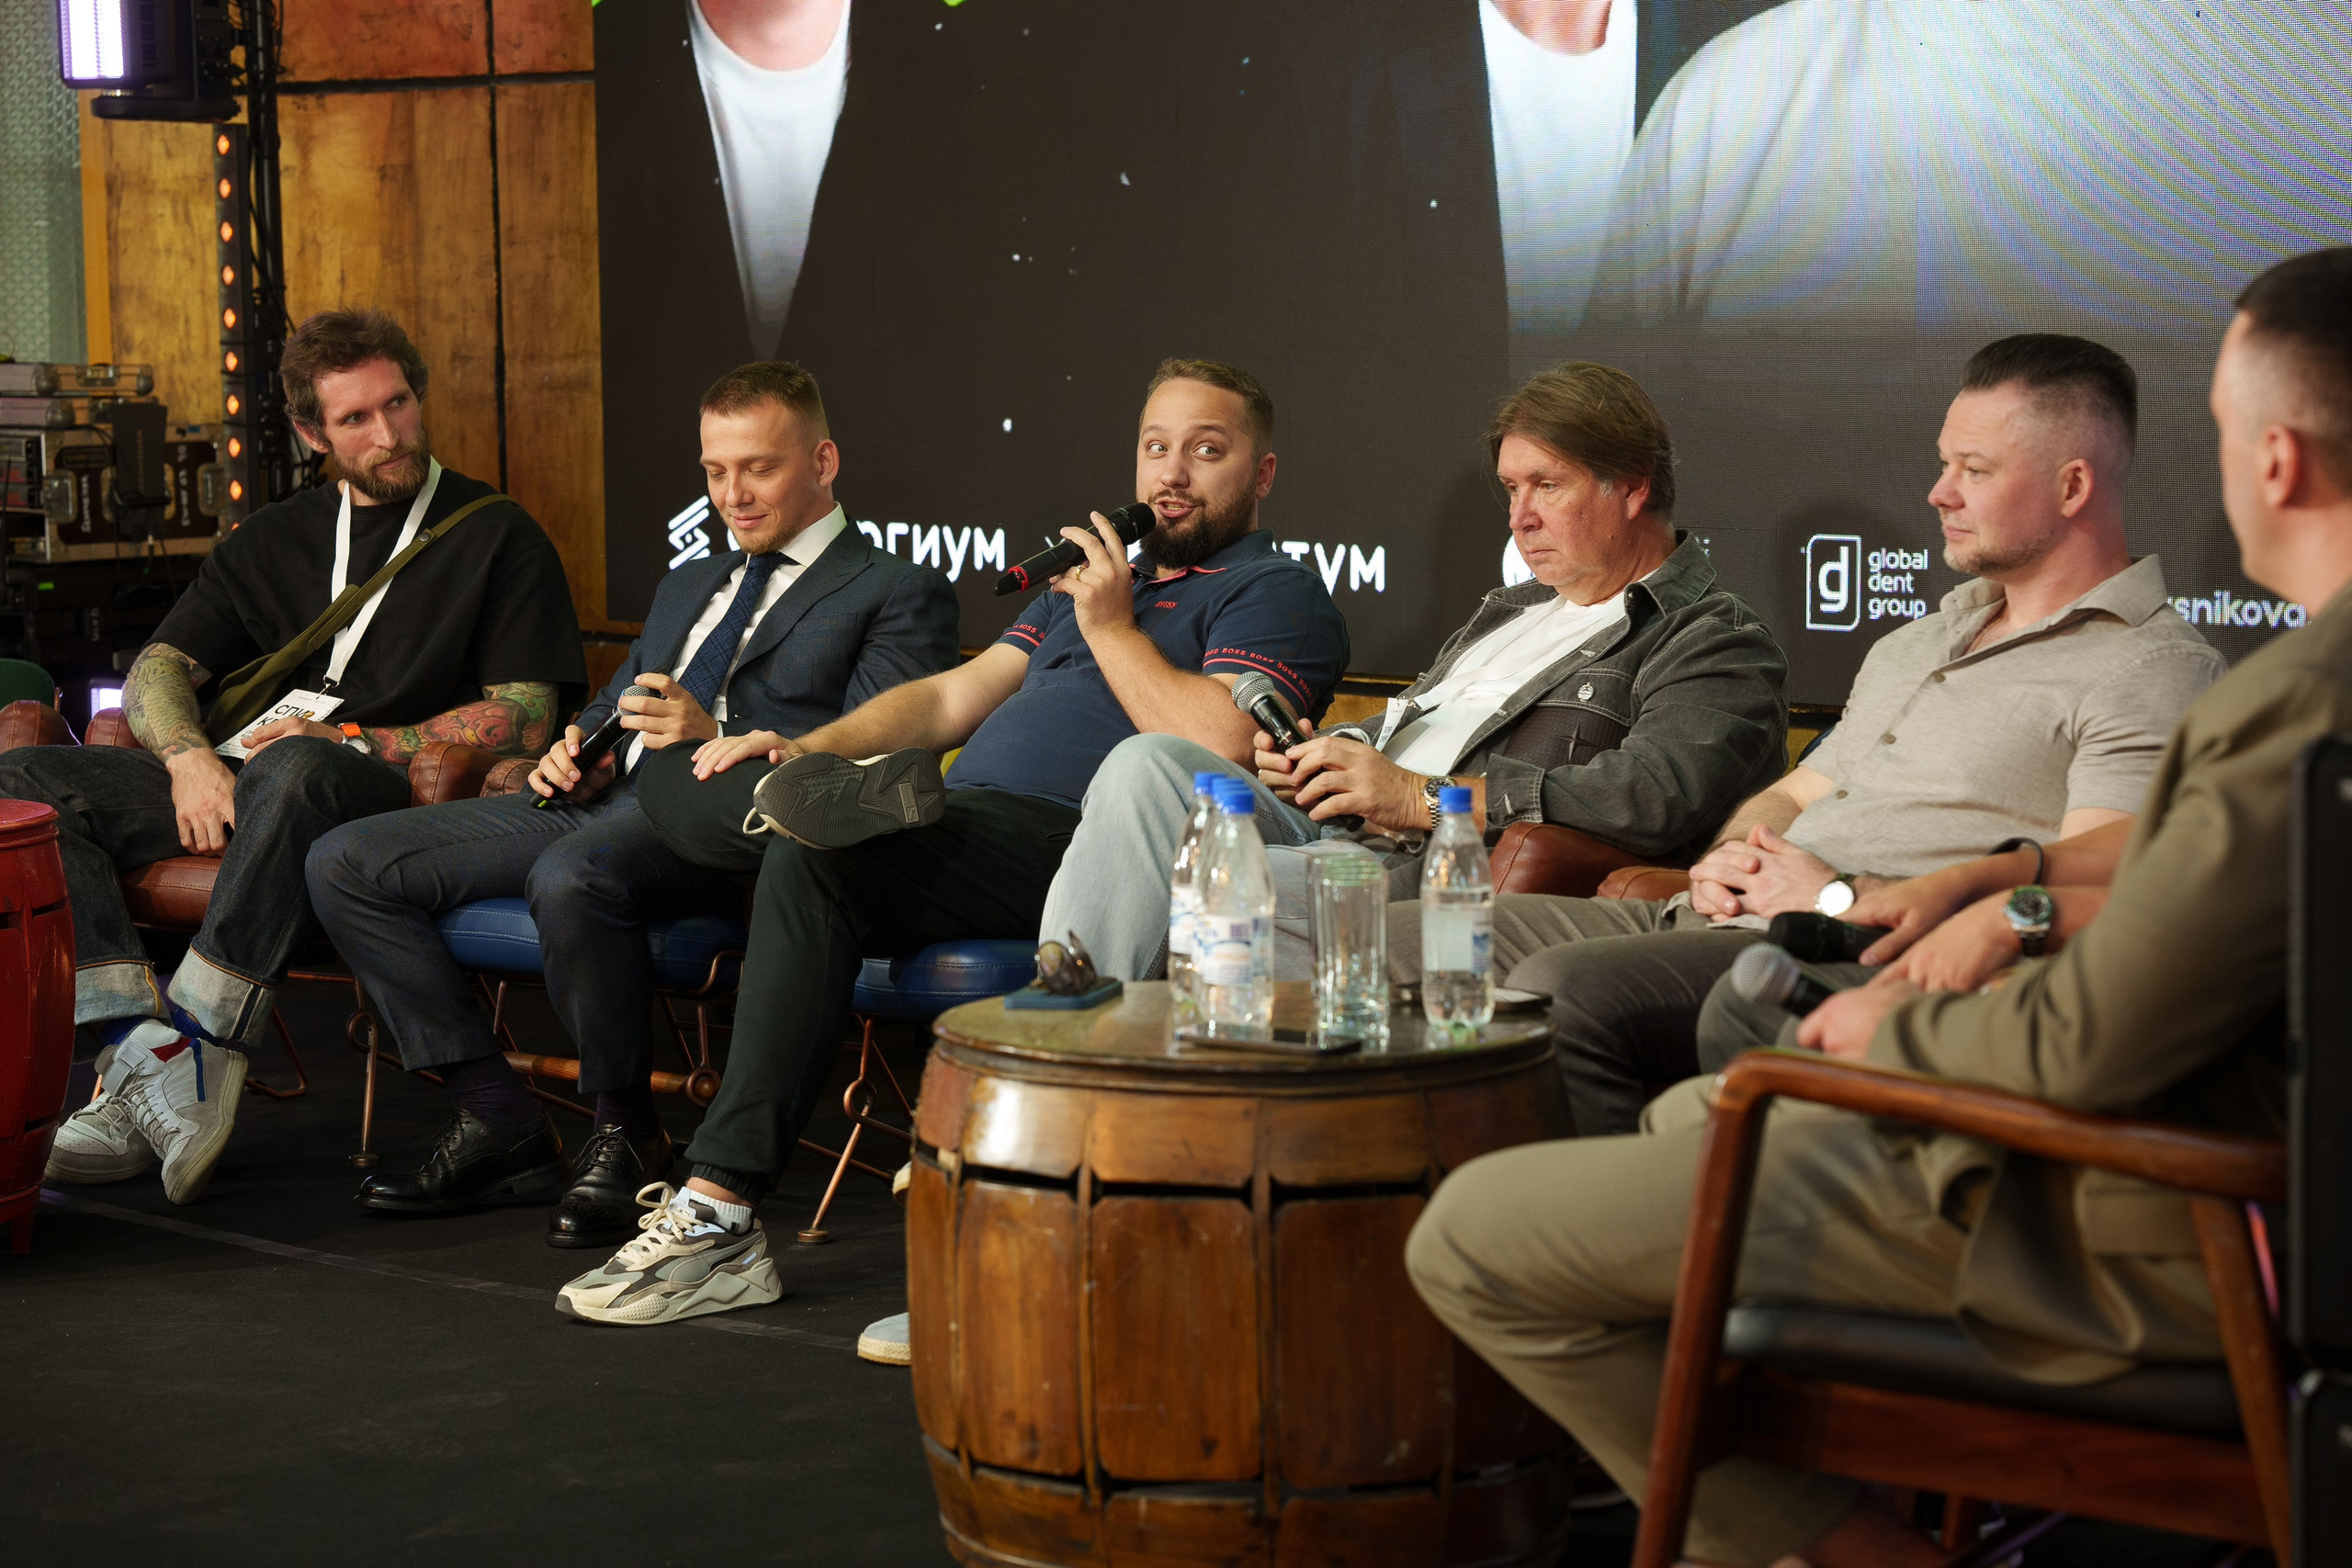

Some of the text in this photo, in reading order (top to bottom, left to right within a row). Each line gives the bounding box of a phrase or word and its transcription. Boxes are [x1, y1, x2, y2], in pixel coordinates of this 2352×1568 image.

[1868, 547, 1928, 571] global
[1868, 571, 1915, 593] dent
[1868, 597, 1927, 620] group
[2166, 589, 2307, 629] snikova
[1222, 647, 1247, 656] BOSS
[1276, 661, 1298, 680] BOSS
